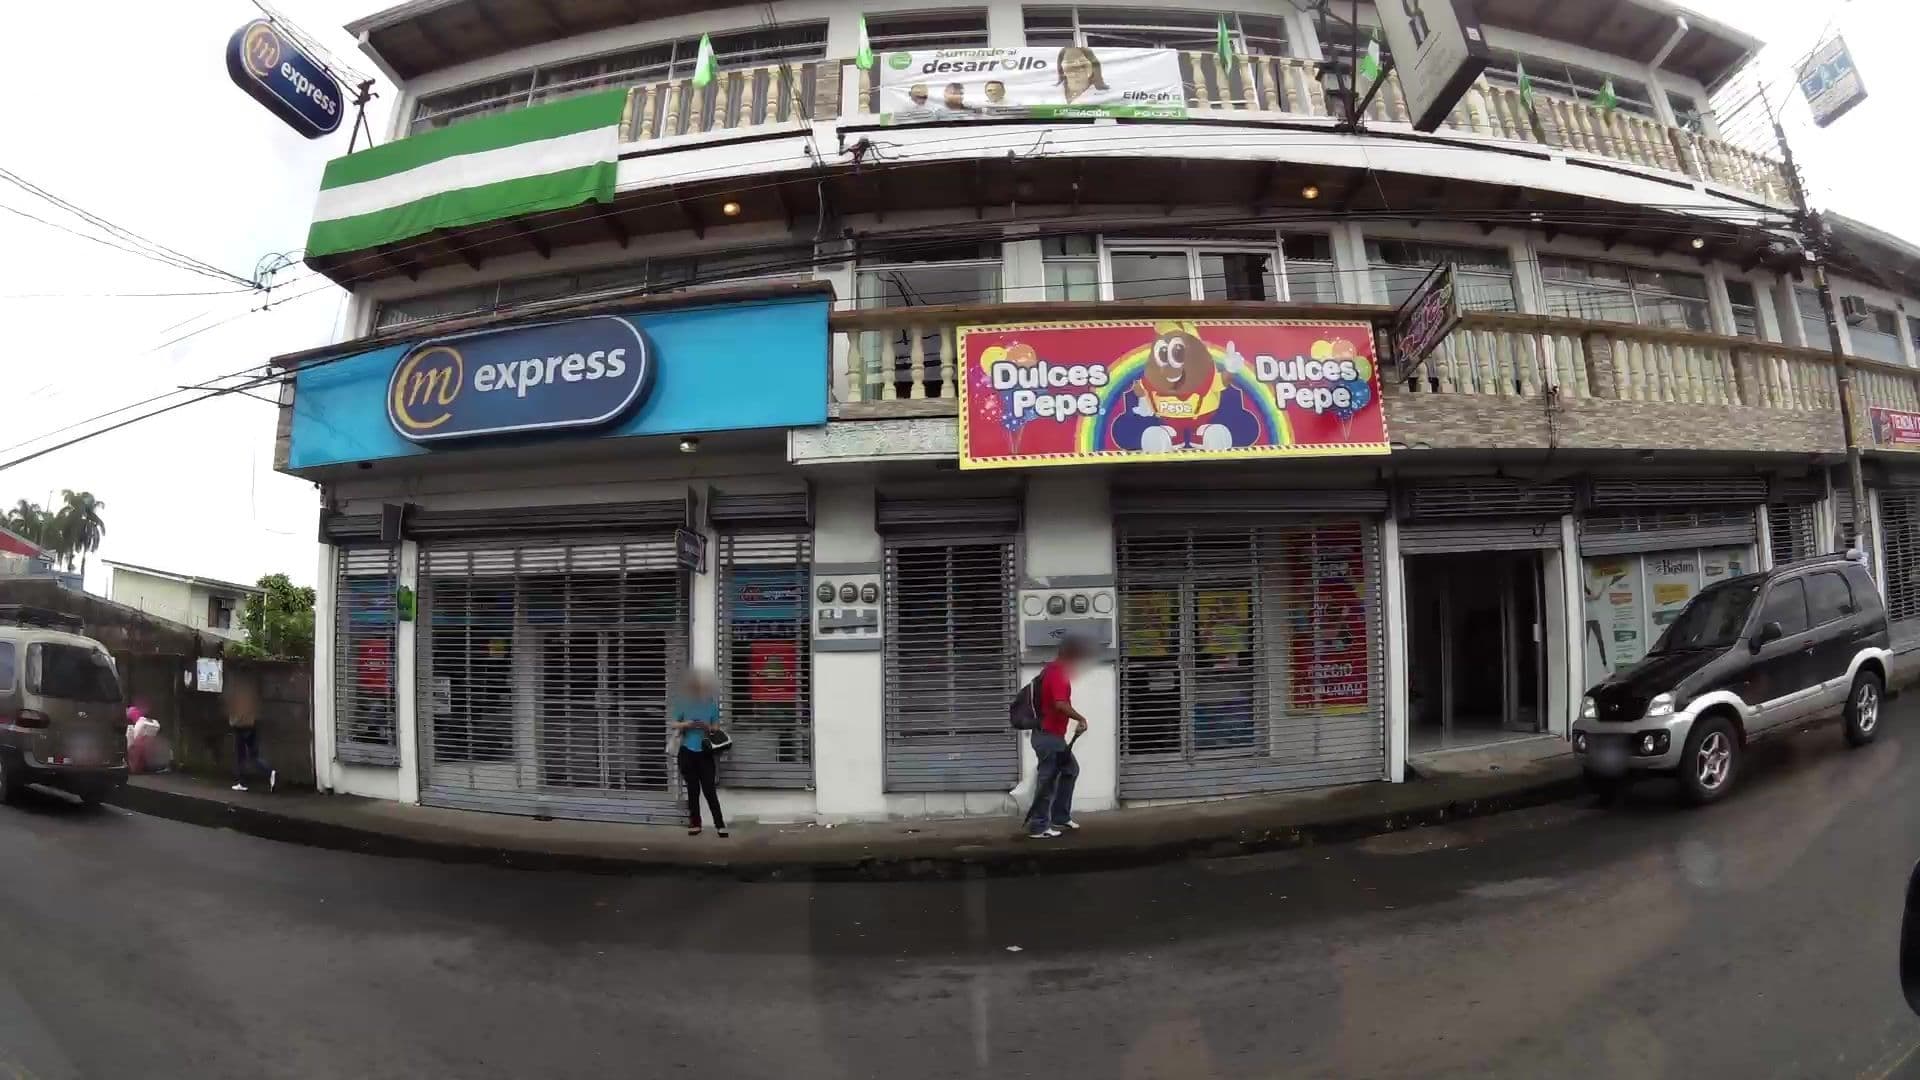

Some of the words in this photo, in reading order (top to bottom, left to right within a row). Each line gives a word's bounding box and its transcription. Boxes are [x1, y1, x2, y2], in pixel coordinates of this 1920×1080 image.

[921, 57, 1048, 75] desarrollo
[280, 62, 336, 115] express
[474, 348, 626, 398] express
[993, 361, 1109, 389] Dulces
[1255, 355, 1358, 382] Dulces
[1013, 389, 1099, 422] Pepe
[1160, 401, 1193, 416] Pepe
[1275, 383, 1352, 414] Pepe
